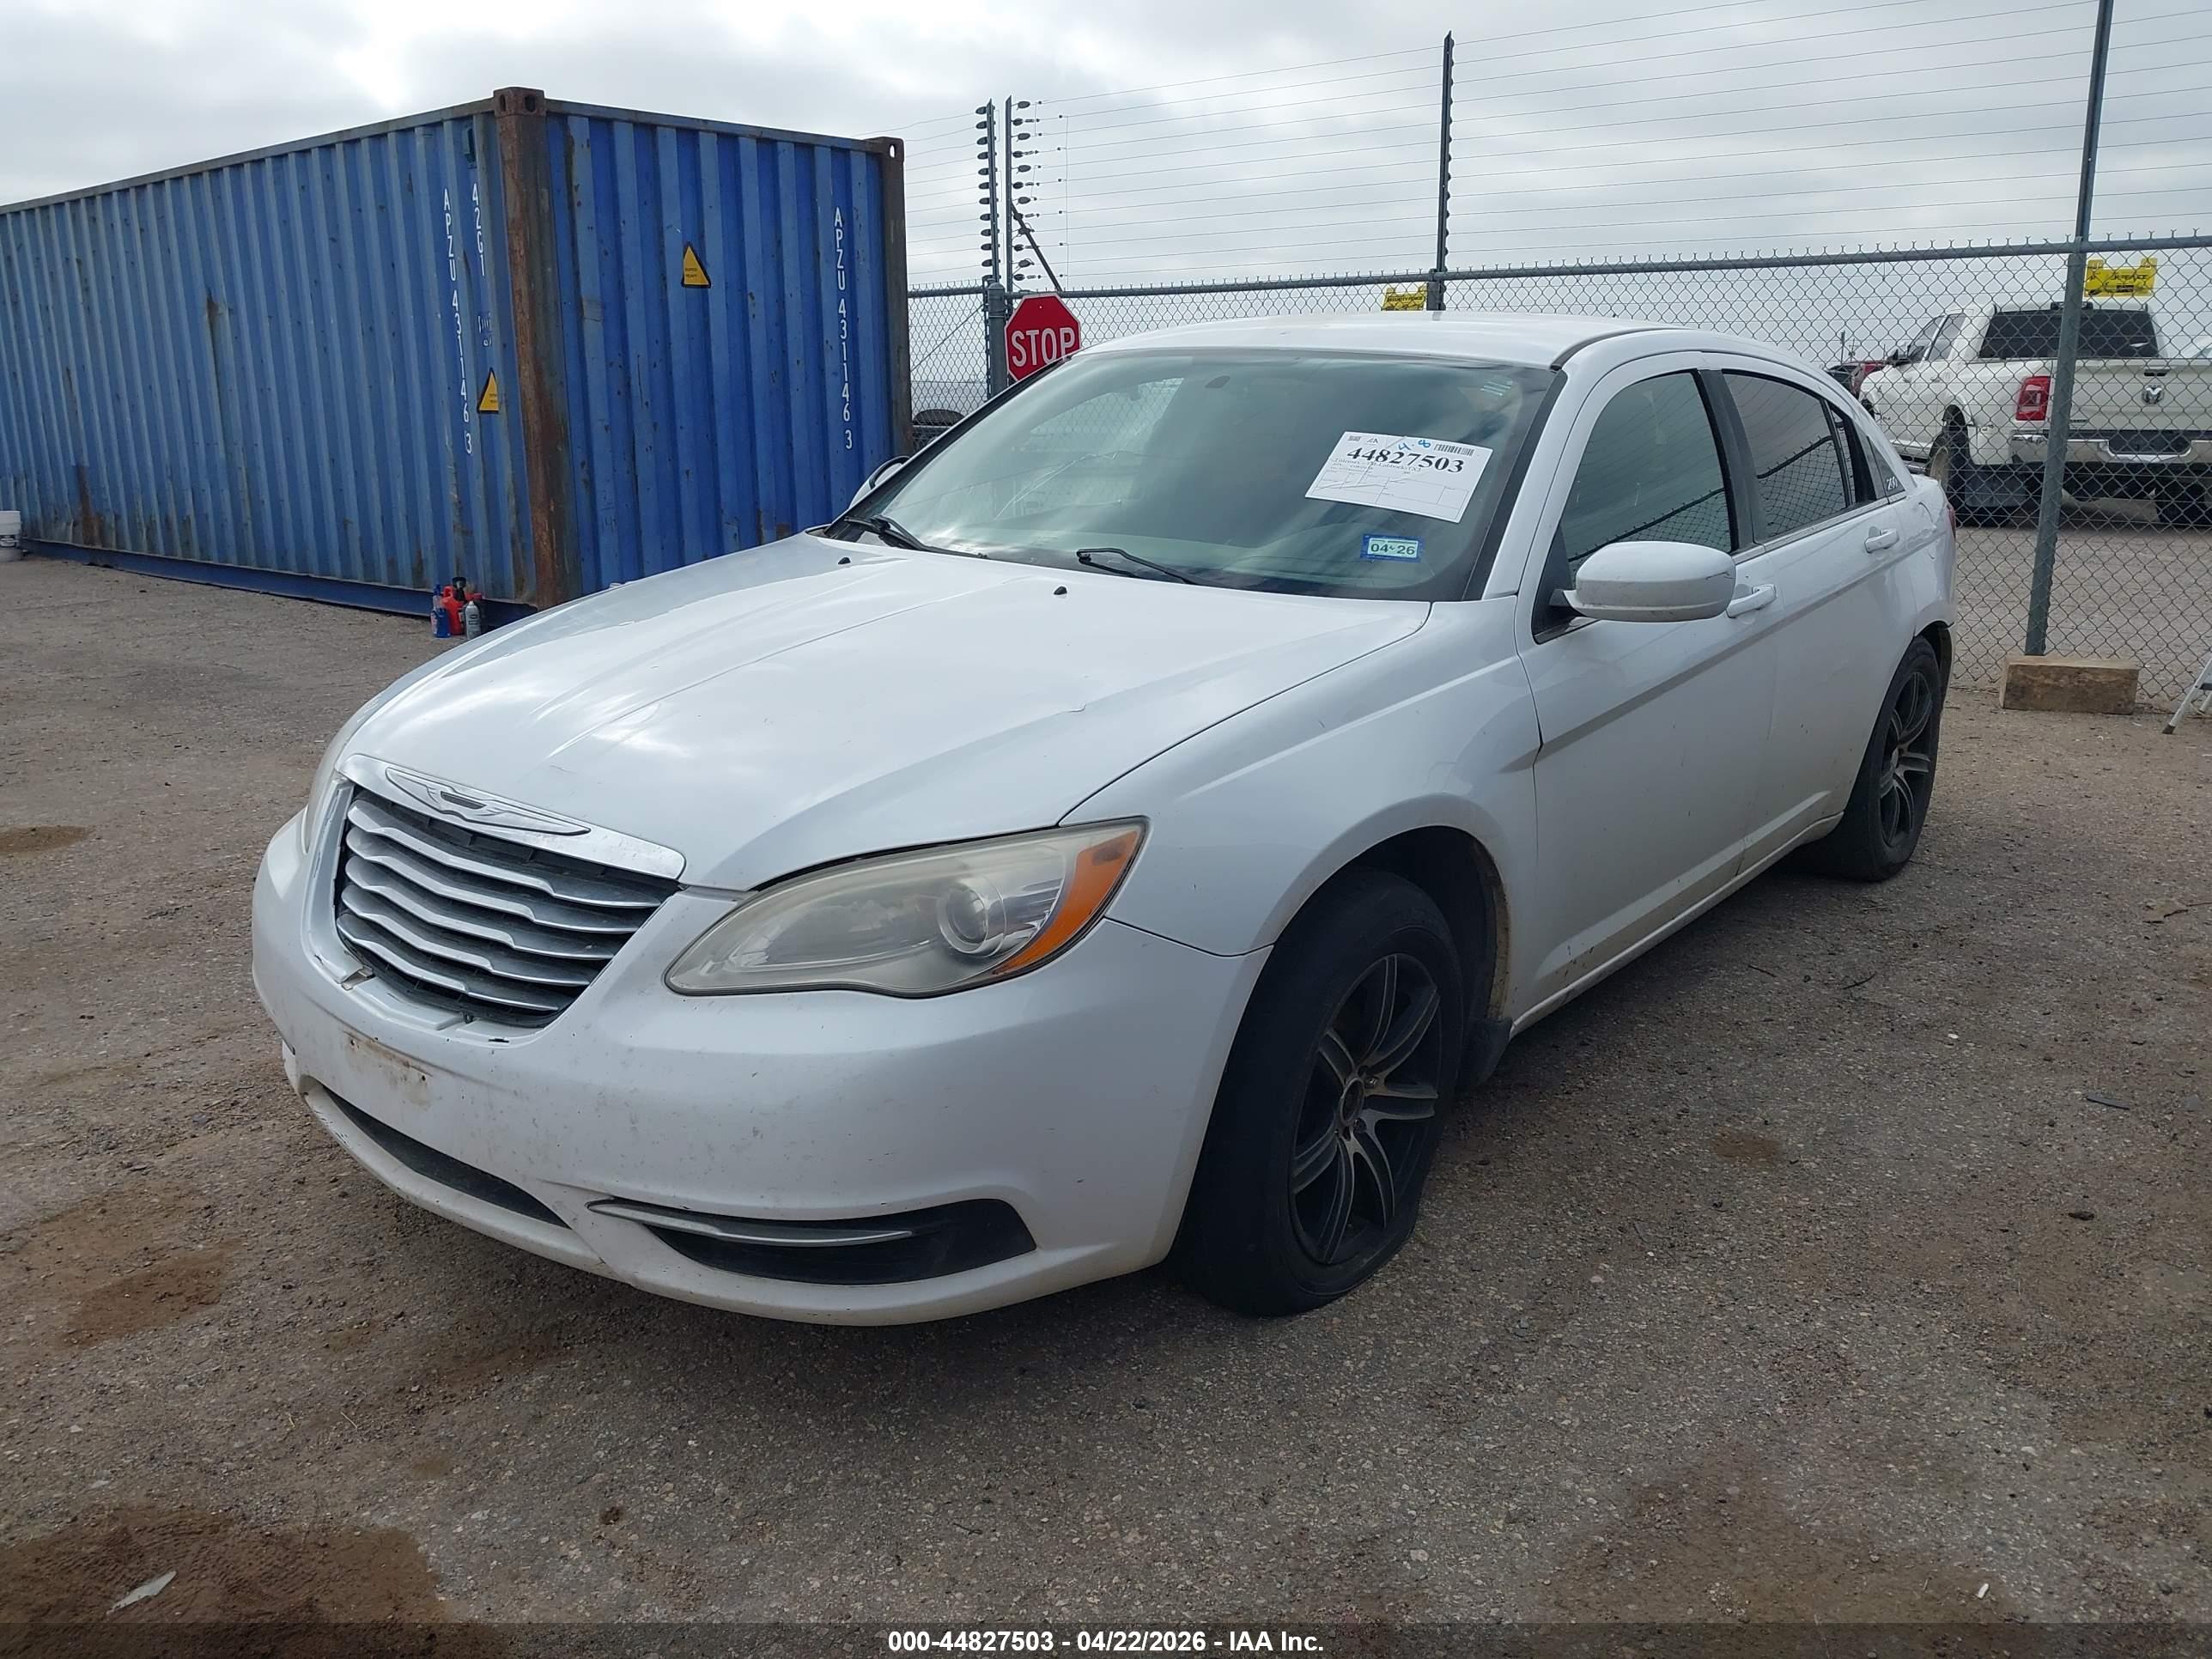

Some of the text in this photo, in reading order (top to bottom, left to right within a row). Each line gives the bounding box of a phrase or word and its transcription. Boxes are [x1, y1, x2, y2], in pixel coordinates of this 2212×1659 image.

[472, 183, 484, 276] 42G1
[444, 188, 472, 454] APZU 431146 3
[834, 206, 853, 449] APZU 431146 3
[1011, 327, 1076, 367] STOP
[1346, 447, 1465, 473] 44827503
[1370, 543, 1416, 556] 04 26
